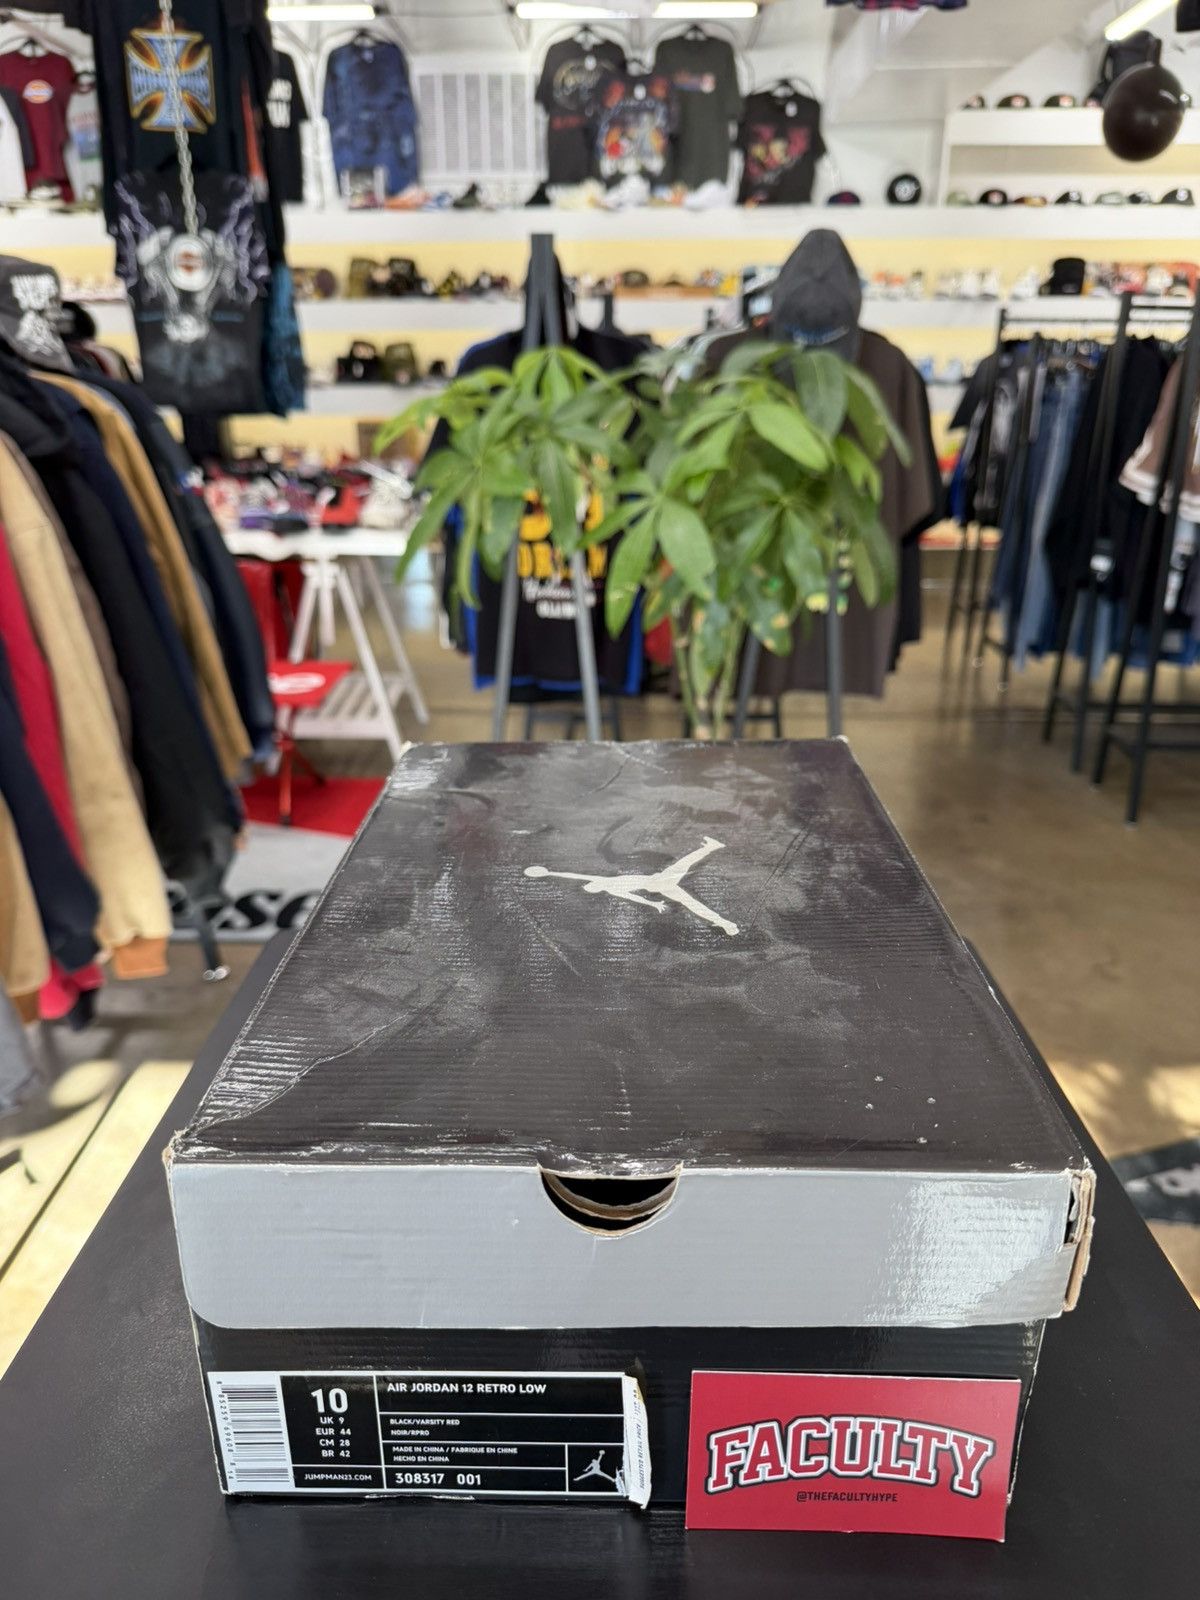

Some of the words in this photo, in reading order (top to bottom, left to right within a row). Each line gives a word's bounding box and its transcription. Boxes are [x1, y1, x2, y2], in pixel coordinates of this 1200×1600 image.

[387, 1383, 407, 1392] AIR
[410, 1383, 459, 1393] JORDAN
[462, 1383, 473, 1393] 12
[477, 1383, 516, 1393] RETRO
[519, 1384, 547, 1394] LOW
[311, 1387, 349, 1413] 10
[320, 1416, 334, 1424] UK
[390, 1418, 445, 1426] BLACK/VARSITY
[446, 1418, 460, 1426] RED
[315, 1427, 335, 1436] EUR
[340, 1428, 351, 1436] 44
[319, 1439, 335, 1447] CM
[339, 1439, 351, 1447] 28
[321, 1449, 334, 1458] BR
[339, 1450, 351, 1458] 42
[451, 1447, 486, 1455] FABRIQUE
[704, 1413, 997, 1496] FACULTY
[304, 1473, 373, 1481] JUMPMAN23.COM
[395, 1472, 445, 1485] 308317
[456, 1473, 482, 1486] 001
[796, 1490, 899, 1503] @THEFACULTYHYPE
